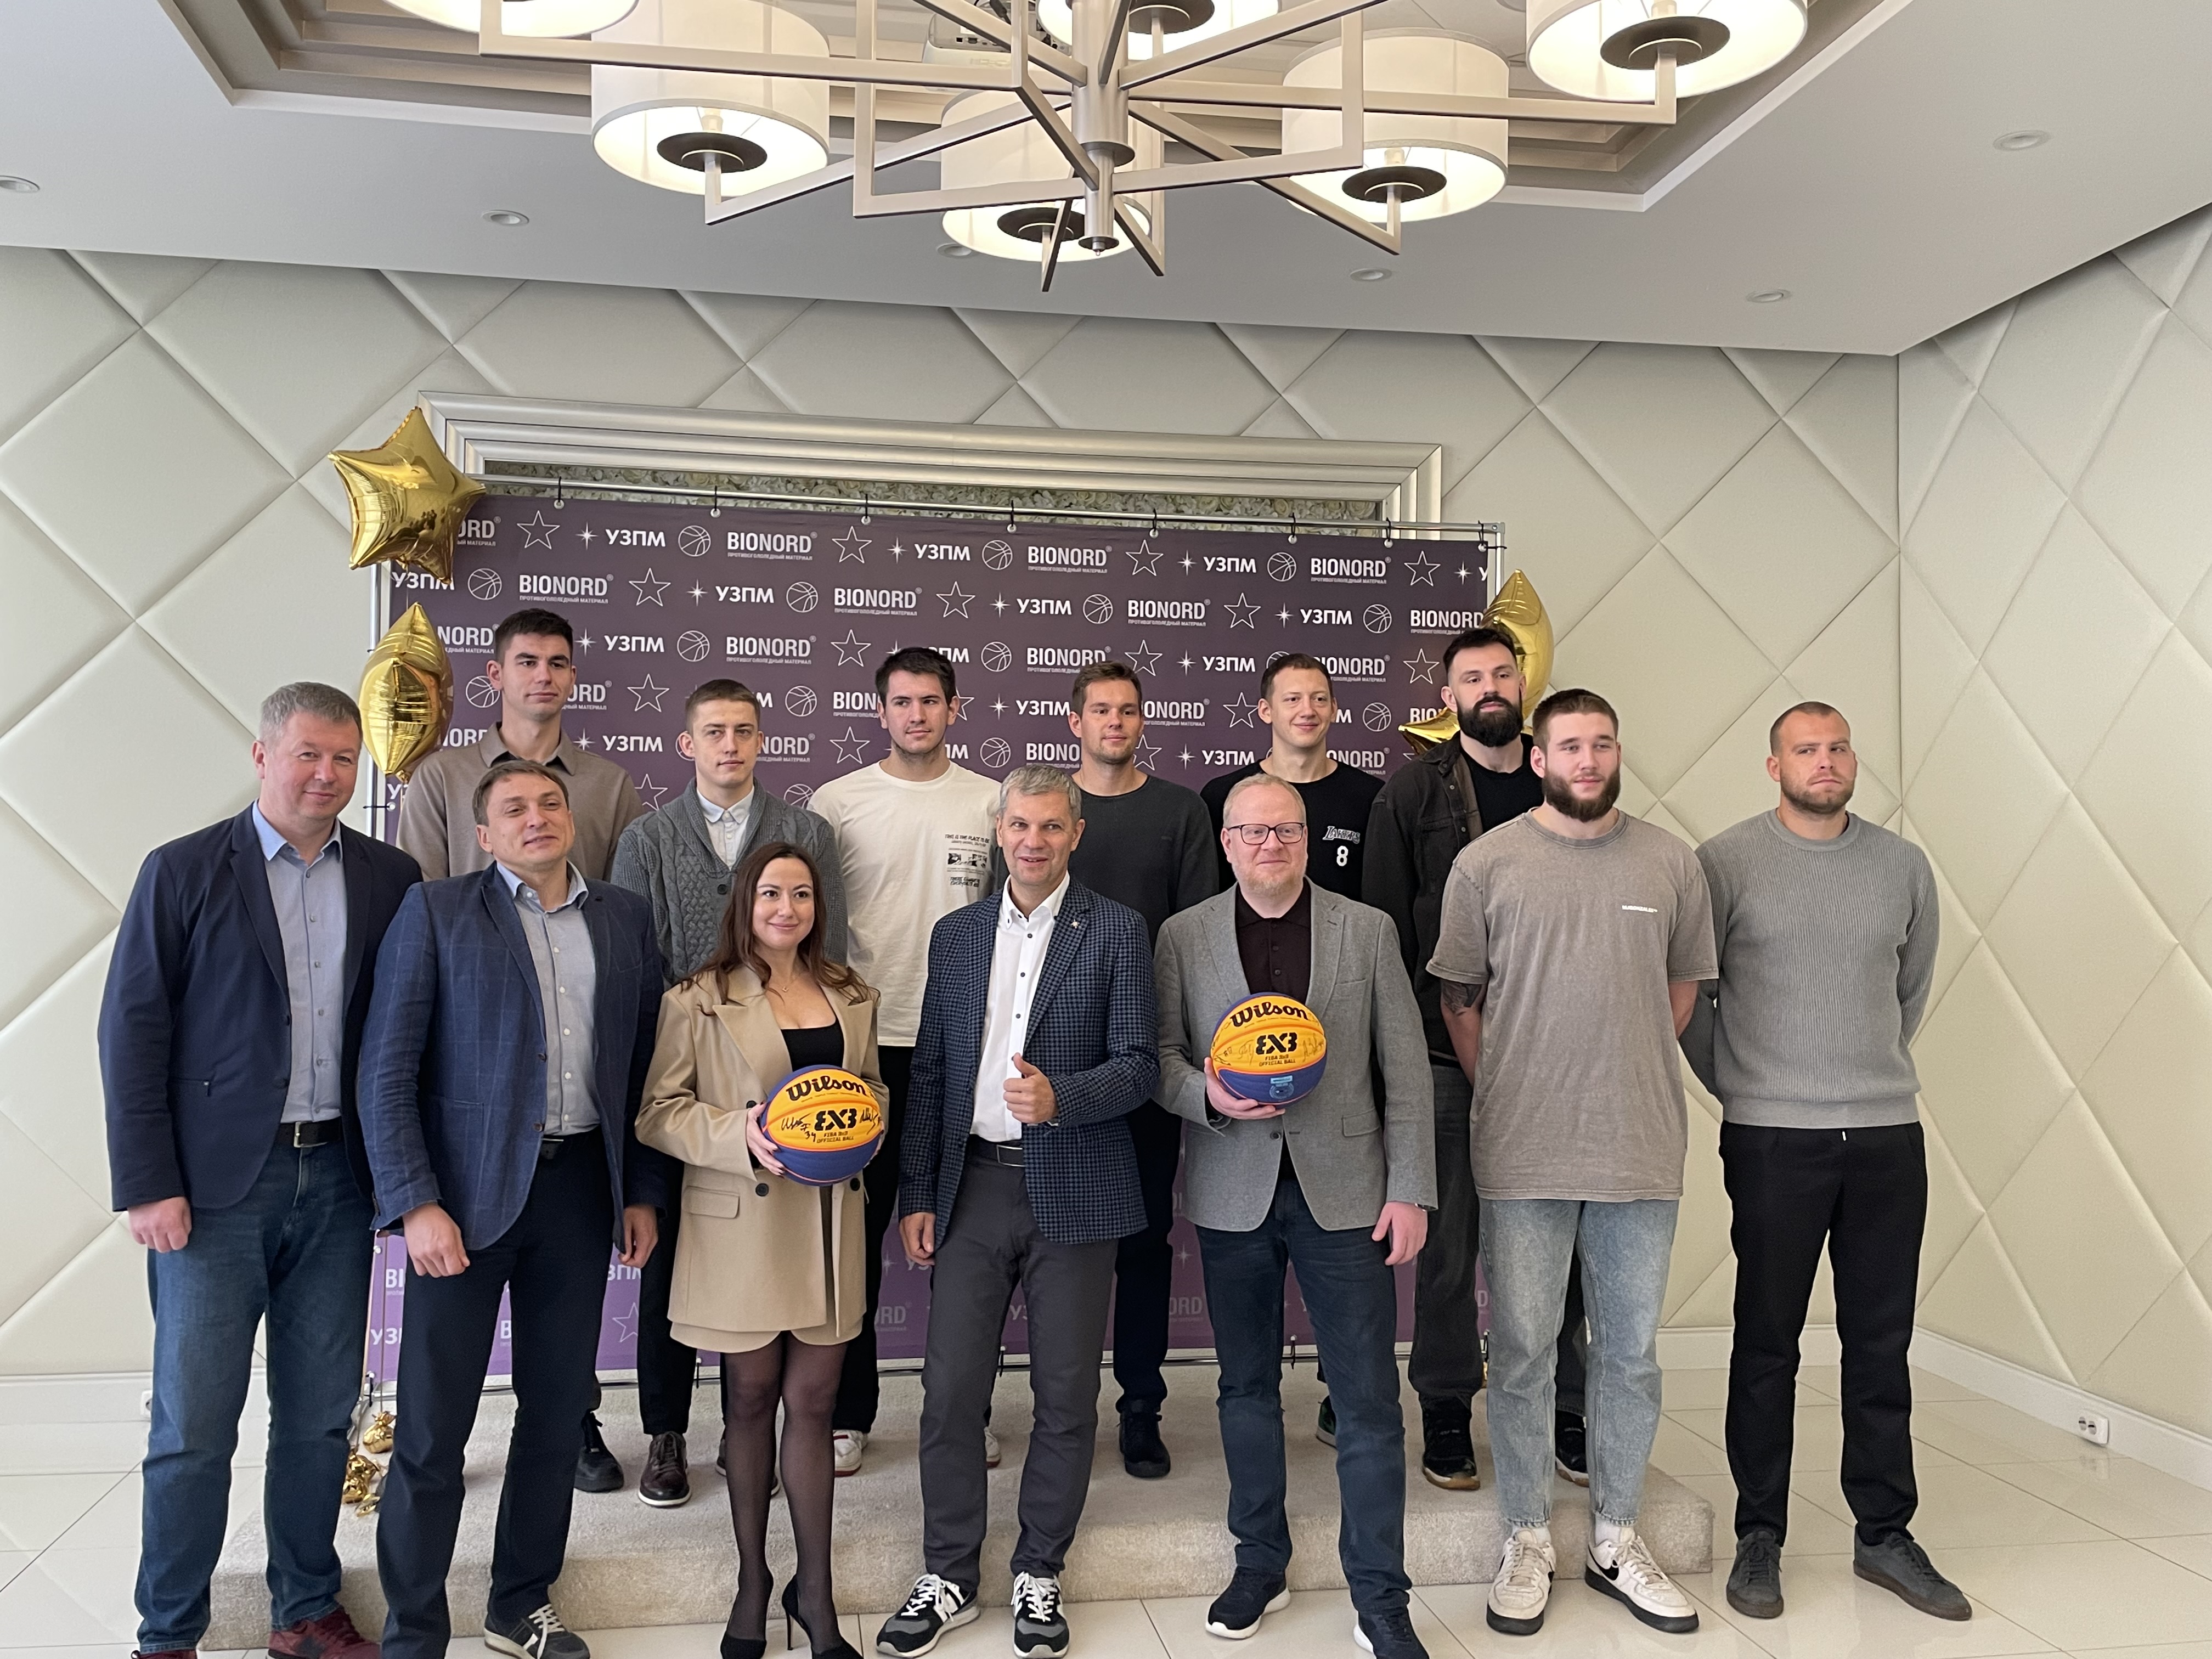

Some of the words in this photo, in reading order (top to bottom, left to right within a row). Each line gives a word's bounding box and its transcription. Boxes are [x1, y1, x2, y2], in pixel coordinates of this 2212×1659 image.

[606, 529, 665, 547] УЗПМ
[915, 543, 970, 561] УЗПМ
[1203, 556, 1256, 573] УЗПМ
[716, 585, 775, 603] УЗПМ
[1017, 599, 1072, 615] УЗПМ
[1300, 608, 1352, 625] УЗПМ
[437, 626, 494, 646] NORD
[605, 635, 665, 652] УЗПМ
[929, 647, 970, 663] ПМ
[1203, 656, 1256, 673] УЗПМ
[833, 692, 877, 710] BION
[1016, 700, 1070, 716] УЗПМ
[1144, 701, 1205, 719] ONORD
[602, 735, 663, 752] УЗПМ
[758, 736, 810, 755] NORD
[1026, 743, 1080, 761] BIONO
[1202, 750, 1255, 766] УЗПМ
[1336, 845, 1348, 867] 8
[1230, 1002, 1308, 1027] Wilson
[786, 1076, 866, 1101] Wilson
[370, 1328, 403, 1345] УЗ
